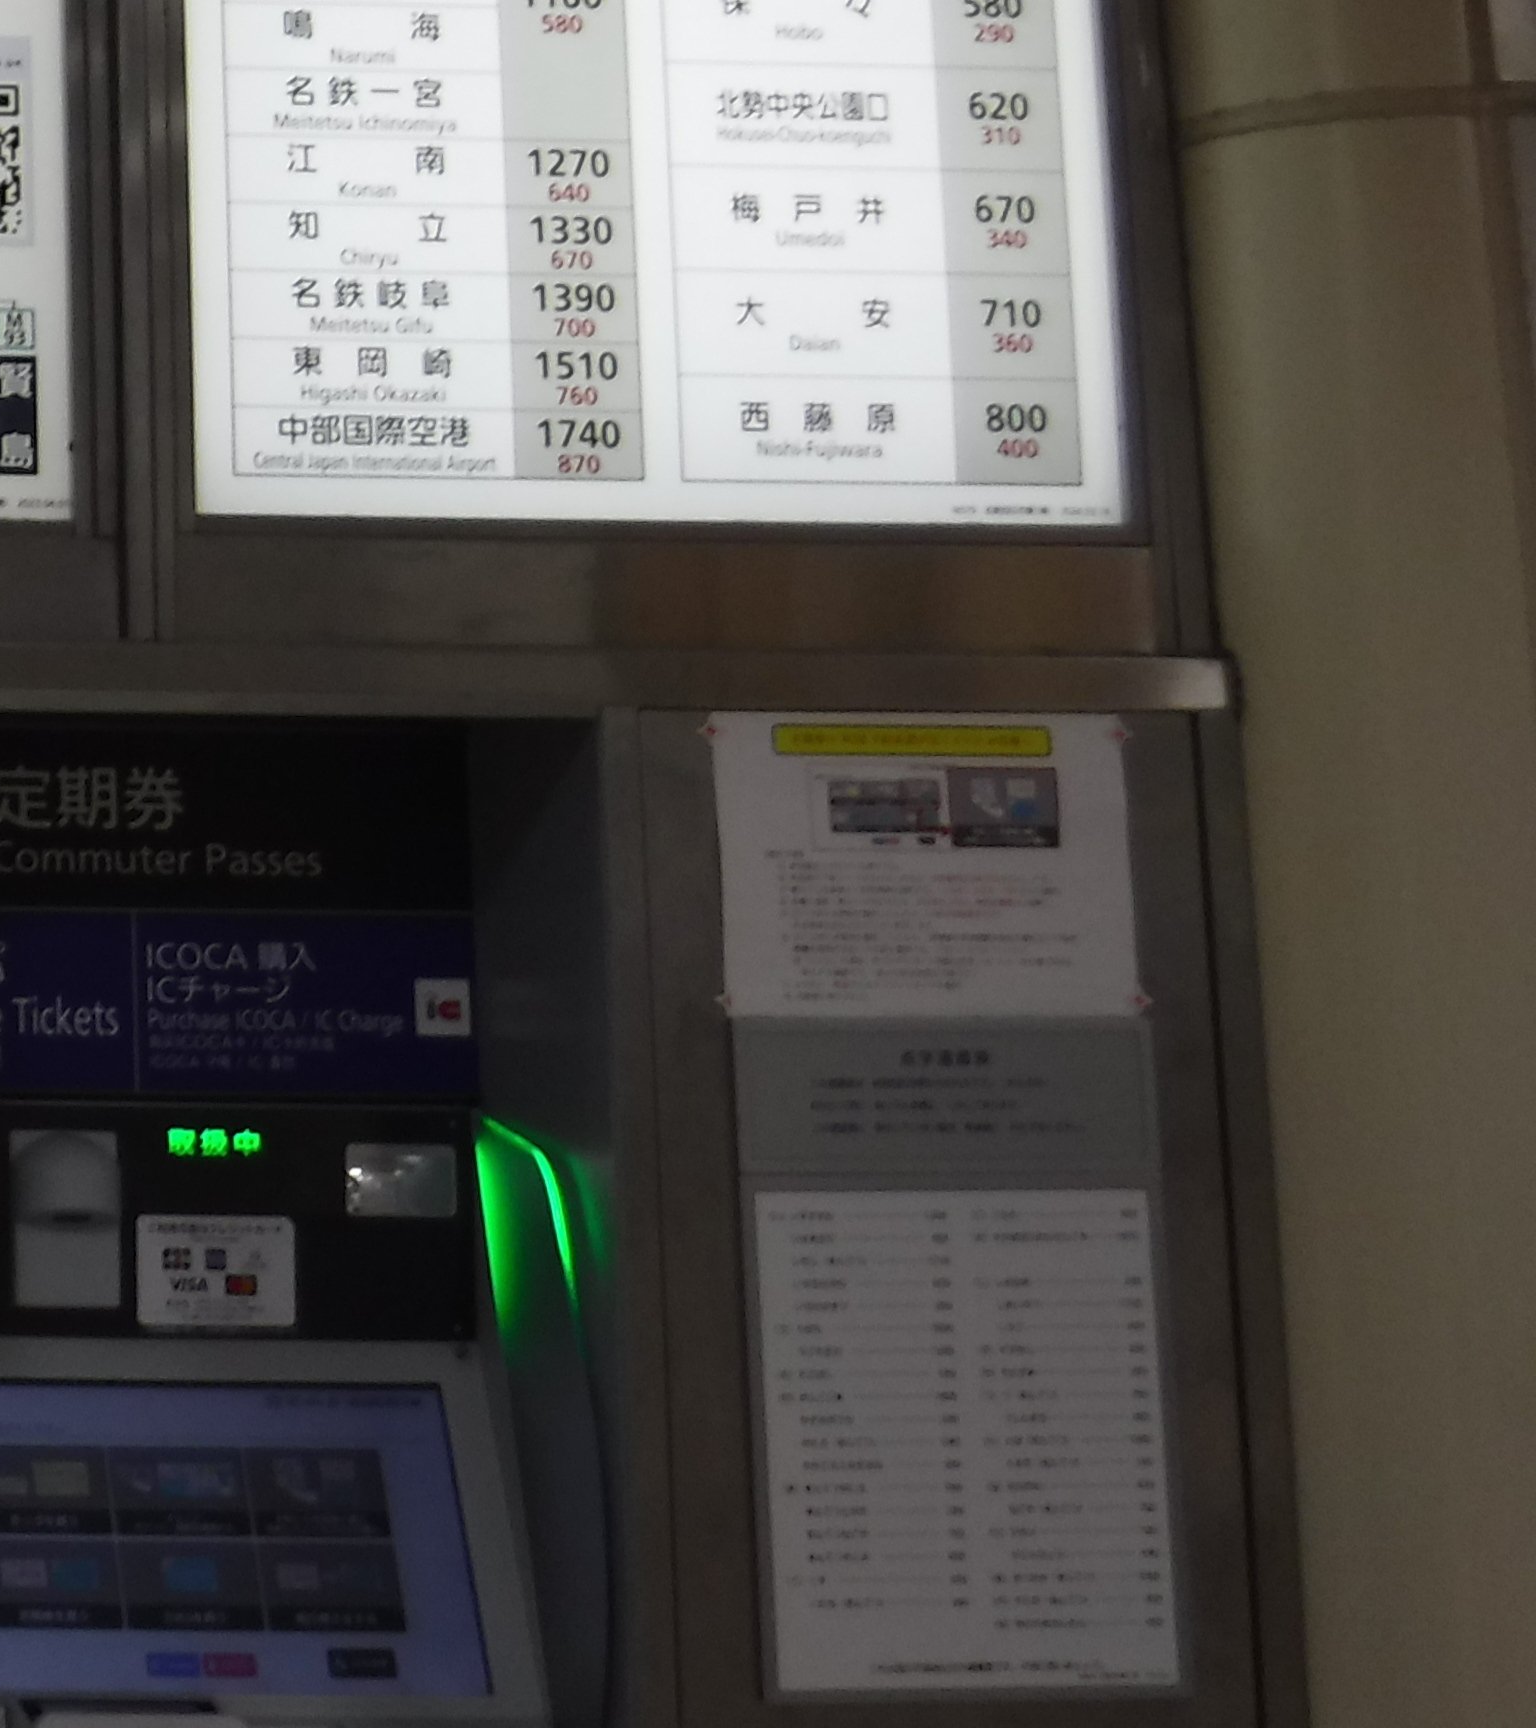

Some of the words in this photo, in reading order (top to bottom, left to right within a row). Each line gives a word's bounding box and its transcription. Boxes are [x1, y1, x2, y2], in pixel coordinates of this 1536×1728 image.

[284, 11, 440, 40] 鳴海
[541, 13, 584, 34] 580
[974, 24, 1014, 44] 290
[286, 77, 442, 107] 名鉄一宮
[717, 91, 890, 121] 北勢中央公園口
[969, 93, 1029, 121] 620
[981, 126, 1021, 146] 310
[288, 145, 446, 174] 江南
[527, 149, 610, 177] 1270
[548, 183, 591, 203] 640
[731, 194, 884, 225] 梅戸井
[975, 196, 1034, 225] 670
[289, 211, 448, 241] 知立
[530, 216, 613, 244] 1330
[551, 250, 593, 271] 670
[292, 279, 451, 309] 名鉄岐阜
[532, 283, 615, 312] 1390
[554, 318, 596, 338] 700
[736, 298, 891, 329] 大安
[981, 300, 1041, 328] 710
[992, 334, 1033, 354] 360
[293, 346, 453, 378] 東岡崎
[534, 351, 618, 381] 1510
[555, 386, 598, 406] 760
[279, 414, 470, 446] 中部国際空港
[739, 402, 895, 434] 西藤原
[986, 403, 1046, 433] 800
[537, 419, 621, 449] 1740
[557, 454, 600, 474] 870
[205, 843, 322, 878] Passes
[146, 942, 247, 970] ICOCA
[258, 943, 316, 971] 購入
[146, 974, 292, 1003] ICチャージ
[13, 997, 118, 1036] Tickets
